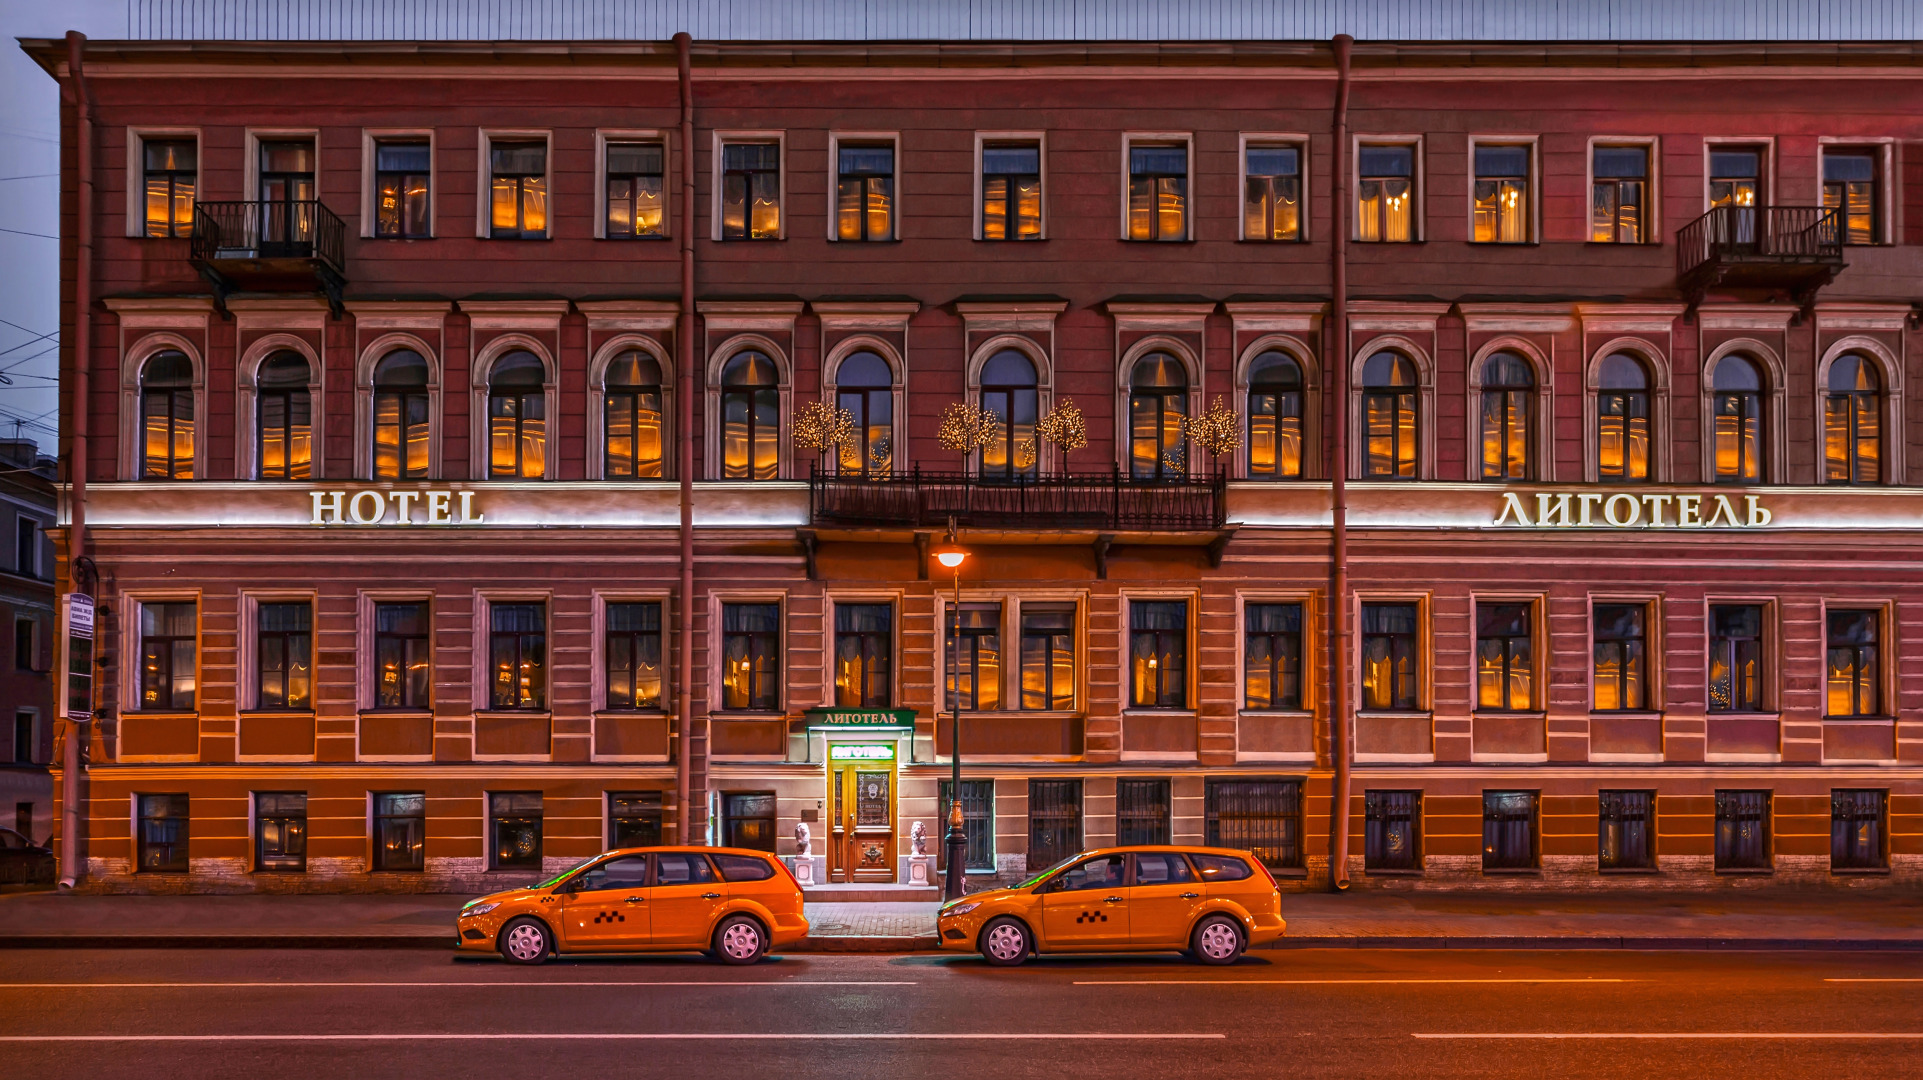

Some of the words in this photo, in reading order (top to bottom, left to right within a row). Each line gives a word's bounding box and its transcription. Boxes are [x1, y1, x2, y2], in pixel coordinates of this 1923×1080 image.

[309, 490, 485, 526] HOTEL
[1493, 492, 1773, 528] ЛИГОТЕЛЬ
[824, 713, 897, 724] ЛИГОТЕЛЬ
